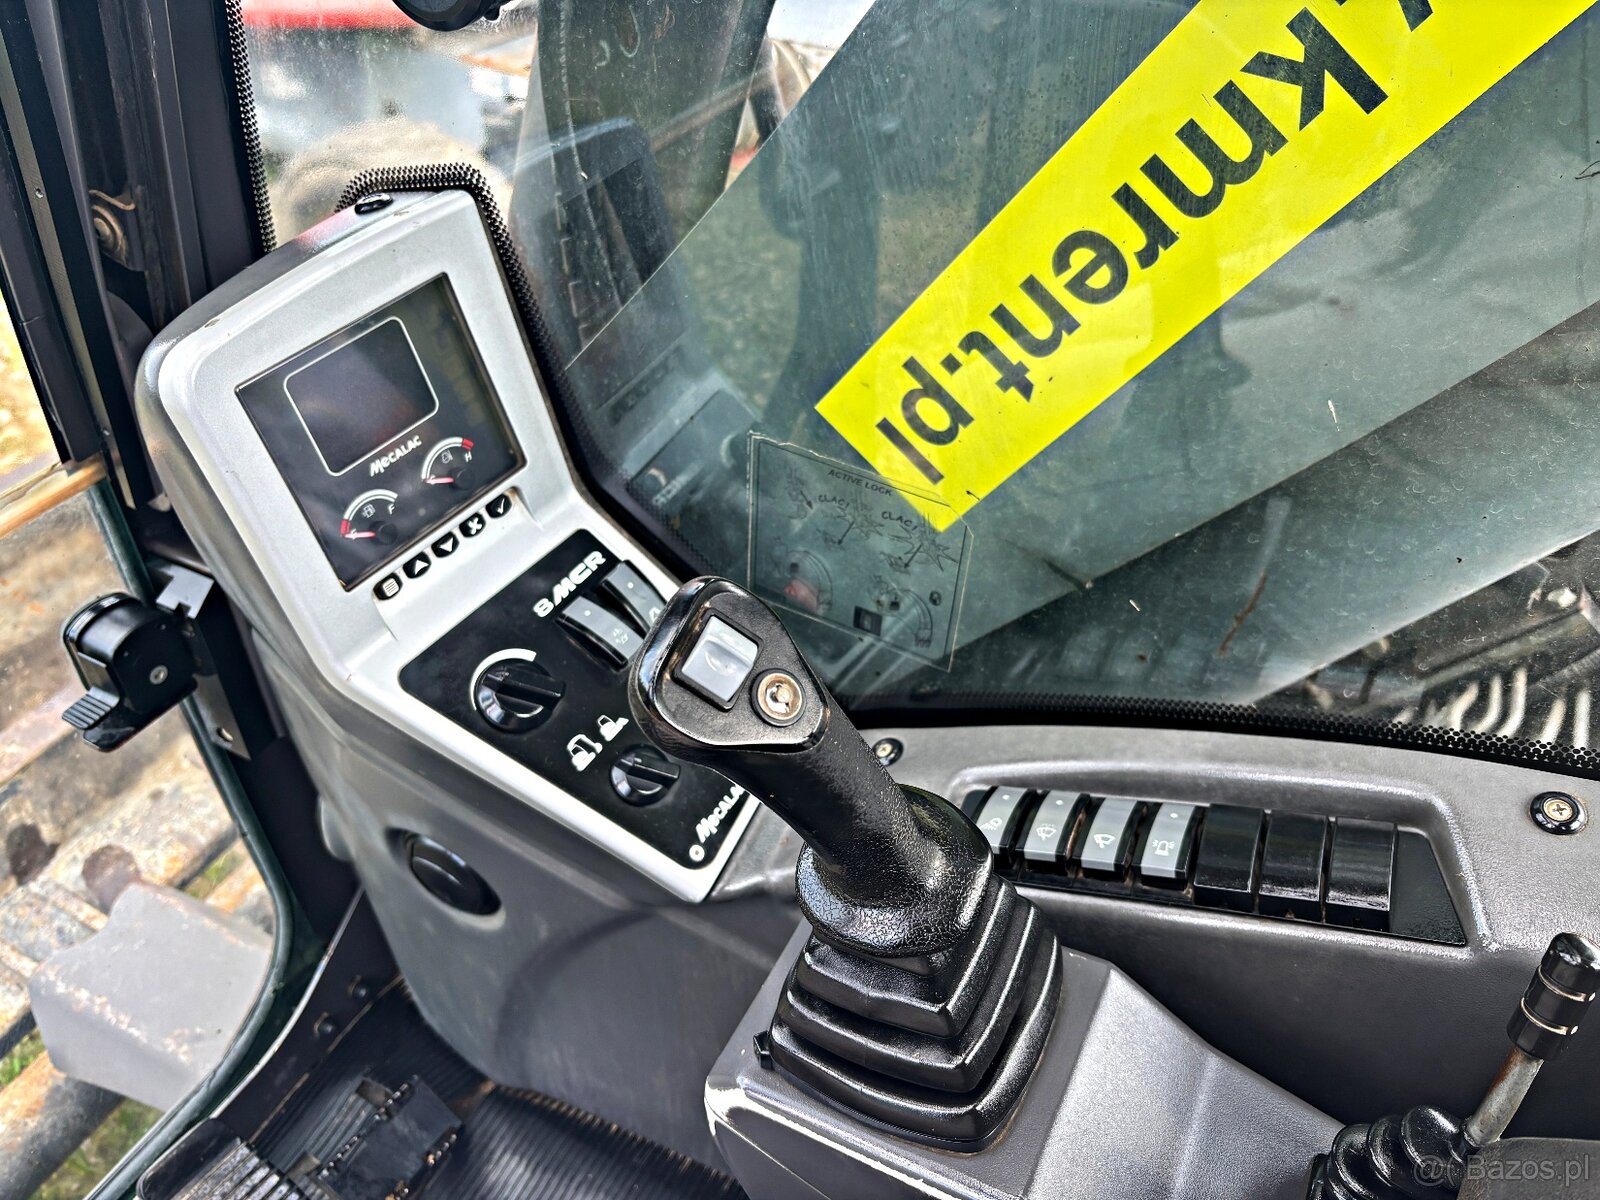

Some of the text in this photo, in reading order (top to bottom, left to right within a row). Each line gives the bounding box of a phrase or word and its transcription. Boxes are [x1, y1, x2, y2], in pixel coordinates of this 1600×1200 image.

[875, 0, 1433, 485] kmrent.pl
[828, 469, 893, 496] ACTIVE LOCK
[696, 784, 746, 843] MeCALA
